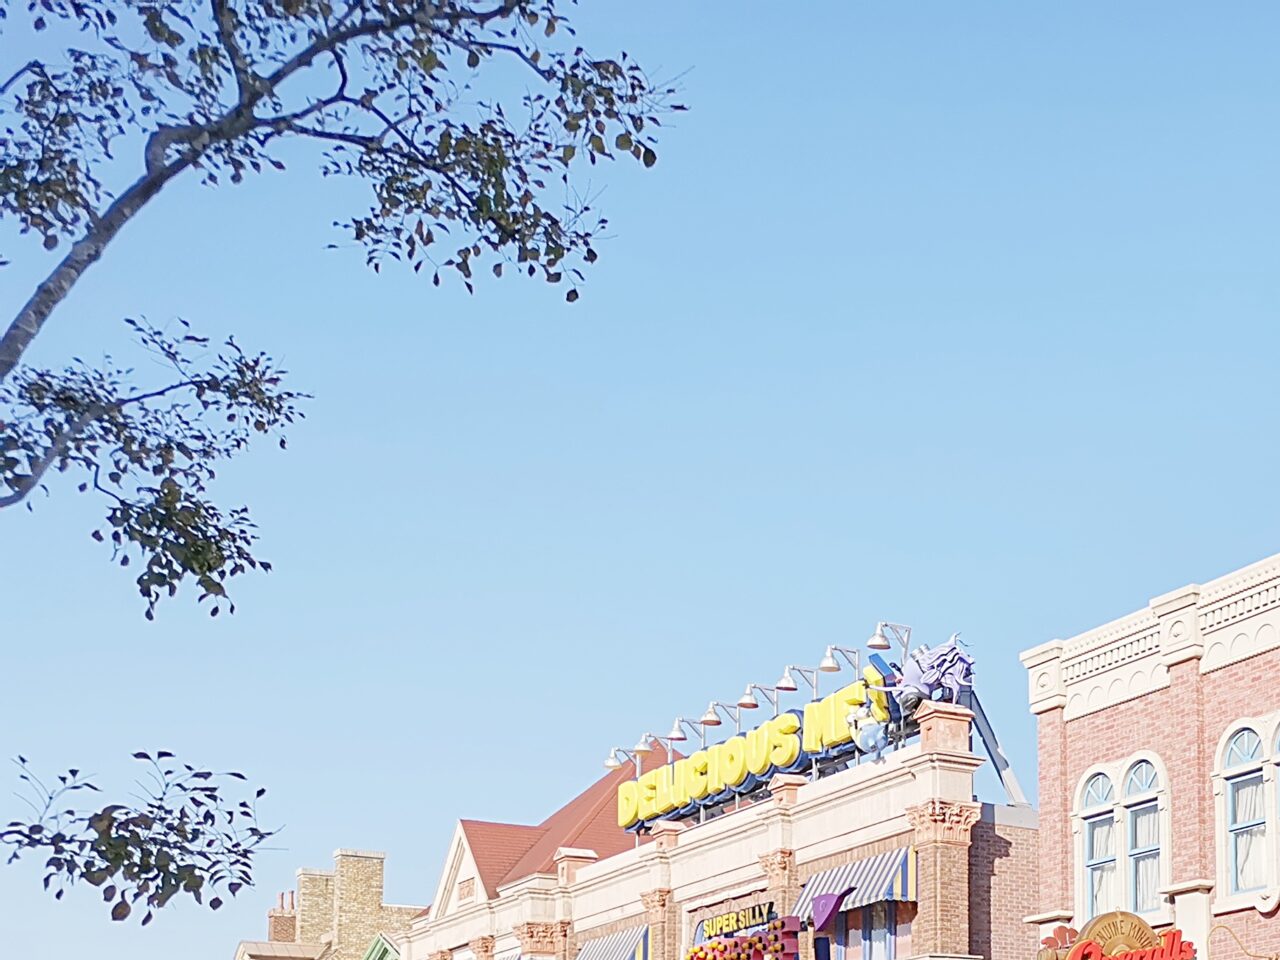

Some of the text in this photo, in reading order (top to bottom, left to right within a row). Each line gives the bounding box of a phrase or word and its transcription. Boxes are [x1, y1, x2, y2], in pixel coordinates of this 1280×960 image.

[617, 711, 803, 829] DELICIOUS
[703, 902, 771, 938] SUPER SILLY
